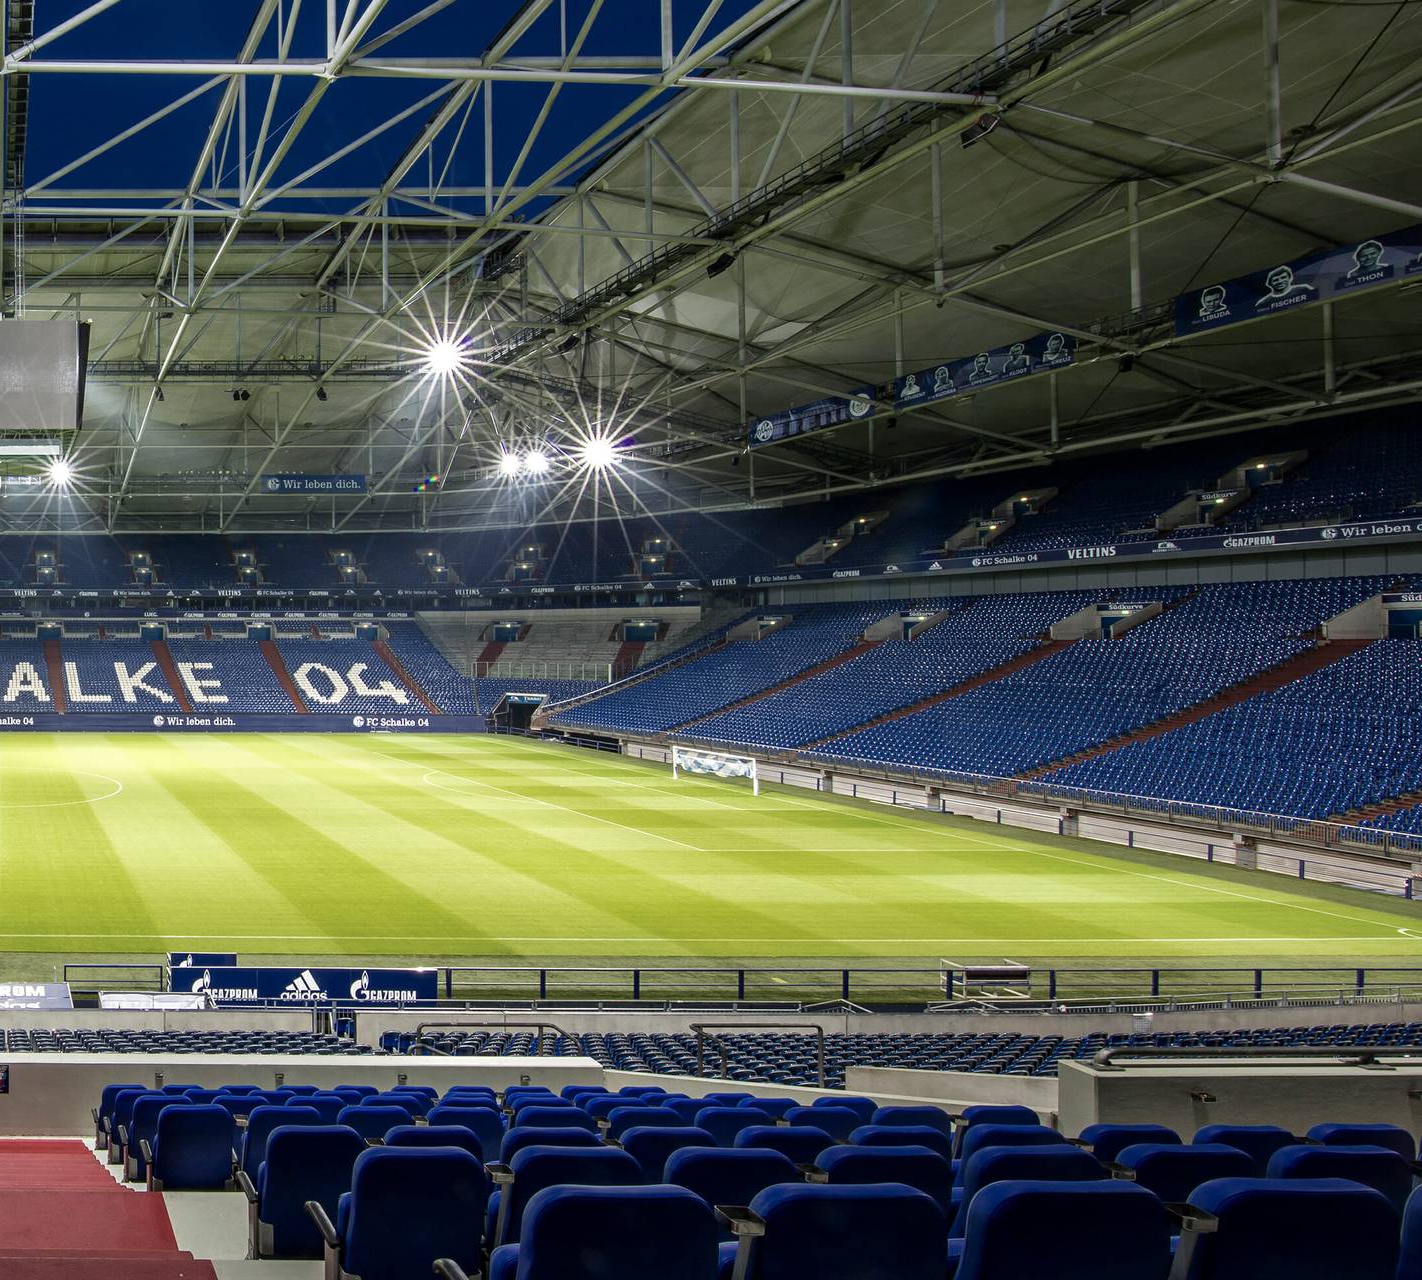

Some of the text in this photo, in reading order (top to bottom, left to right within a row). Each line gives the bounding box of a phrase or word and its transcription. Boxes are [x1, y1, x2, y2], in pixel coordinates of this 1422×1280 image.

[1357, 271, 1384, 284] THON
[1271, 294, 1307, 309] FISCHER
[282, 479, 361, 489] Wir leben dich.
[1342, 526, 1368, 538] Wir
[1371, 523, 1411, 536] leben
[1232, 535, 1276, 547] GAZPROM
[1067, 546, 1116, 559] VELTINS
[982, 554, 1038, 565] FC Schalke 04
[711, 577, 737, 587] VELTINS
[292, 662, 411, 706] 04
[23, 716, 34, 725] 04
[167, 717, 236, 726] Wir leben dich.
[366, 717, 429, 727] FC Schalke 04
[209, 987, 258, 1000] GAZPROM
[280, 988, 328, 1001] adidas
[368, 988, 417, 1001] GAZPROM
